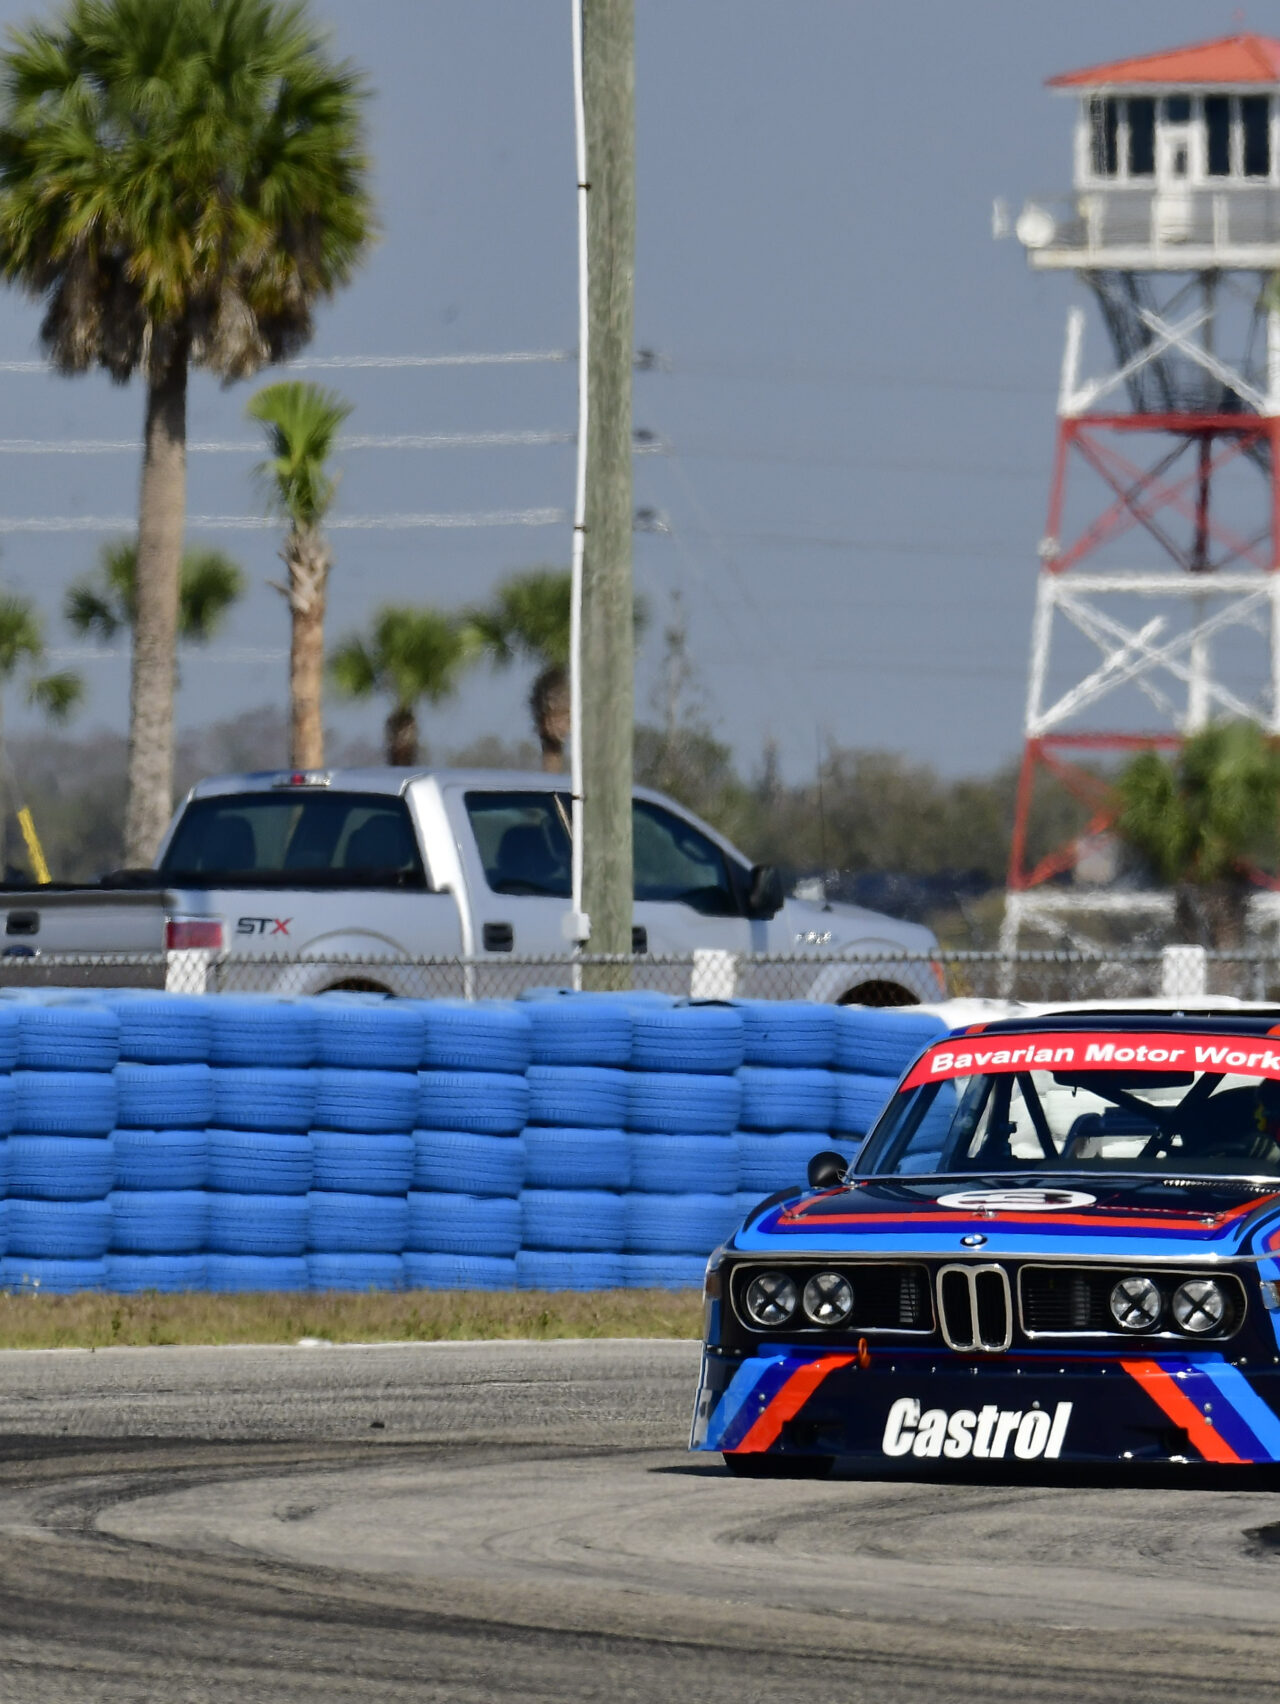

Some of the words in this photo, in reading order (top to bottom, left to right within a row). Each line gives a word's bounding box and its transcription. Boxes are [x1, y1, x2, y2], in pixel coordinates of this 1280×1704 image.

[236, 917, 293, 935] STX
[930, 1045, 1074, 1073] Bavarian
[1085, 1043, 1186, 1063] Motor
[882, 1397, 1074, 1460] Castrol
